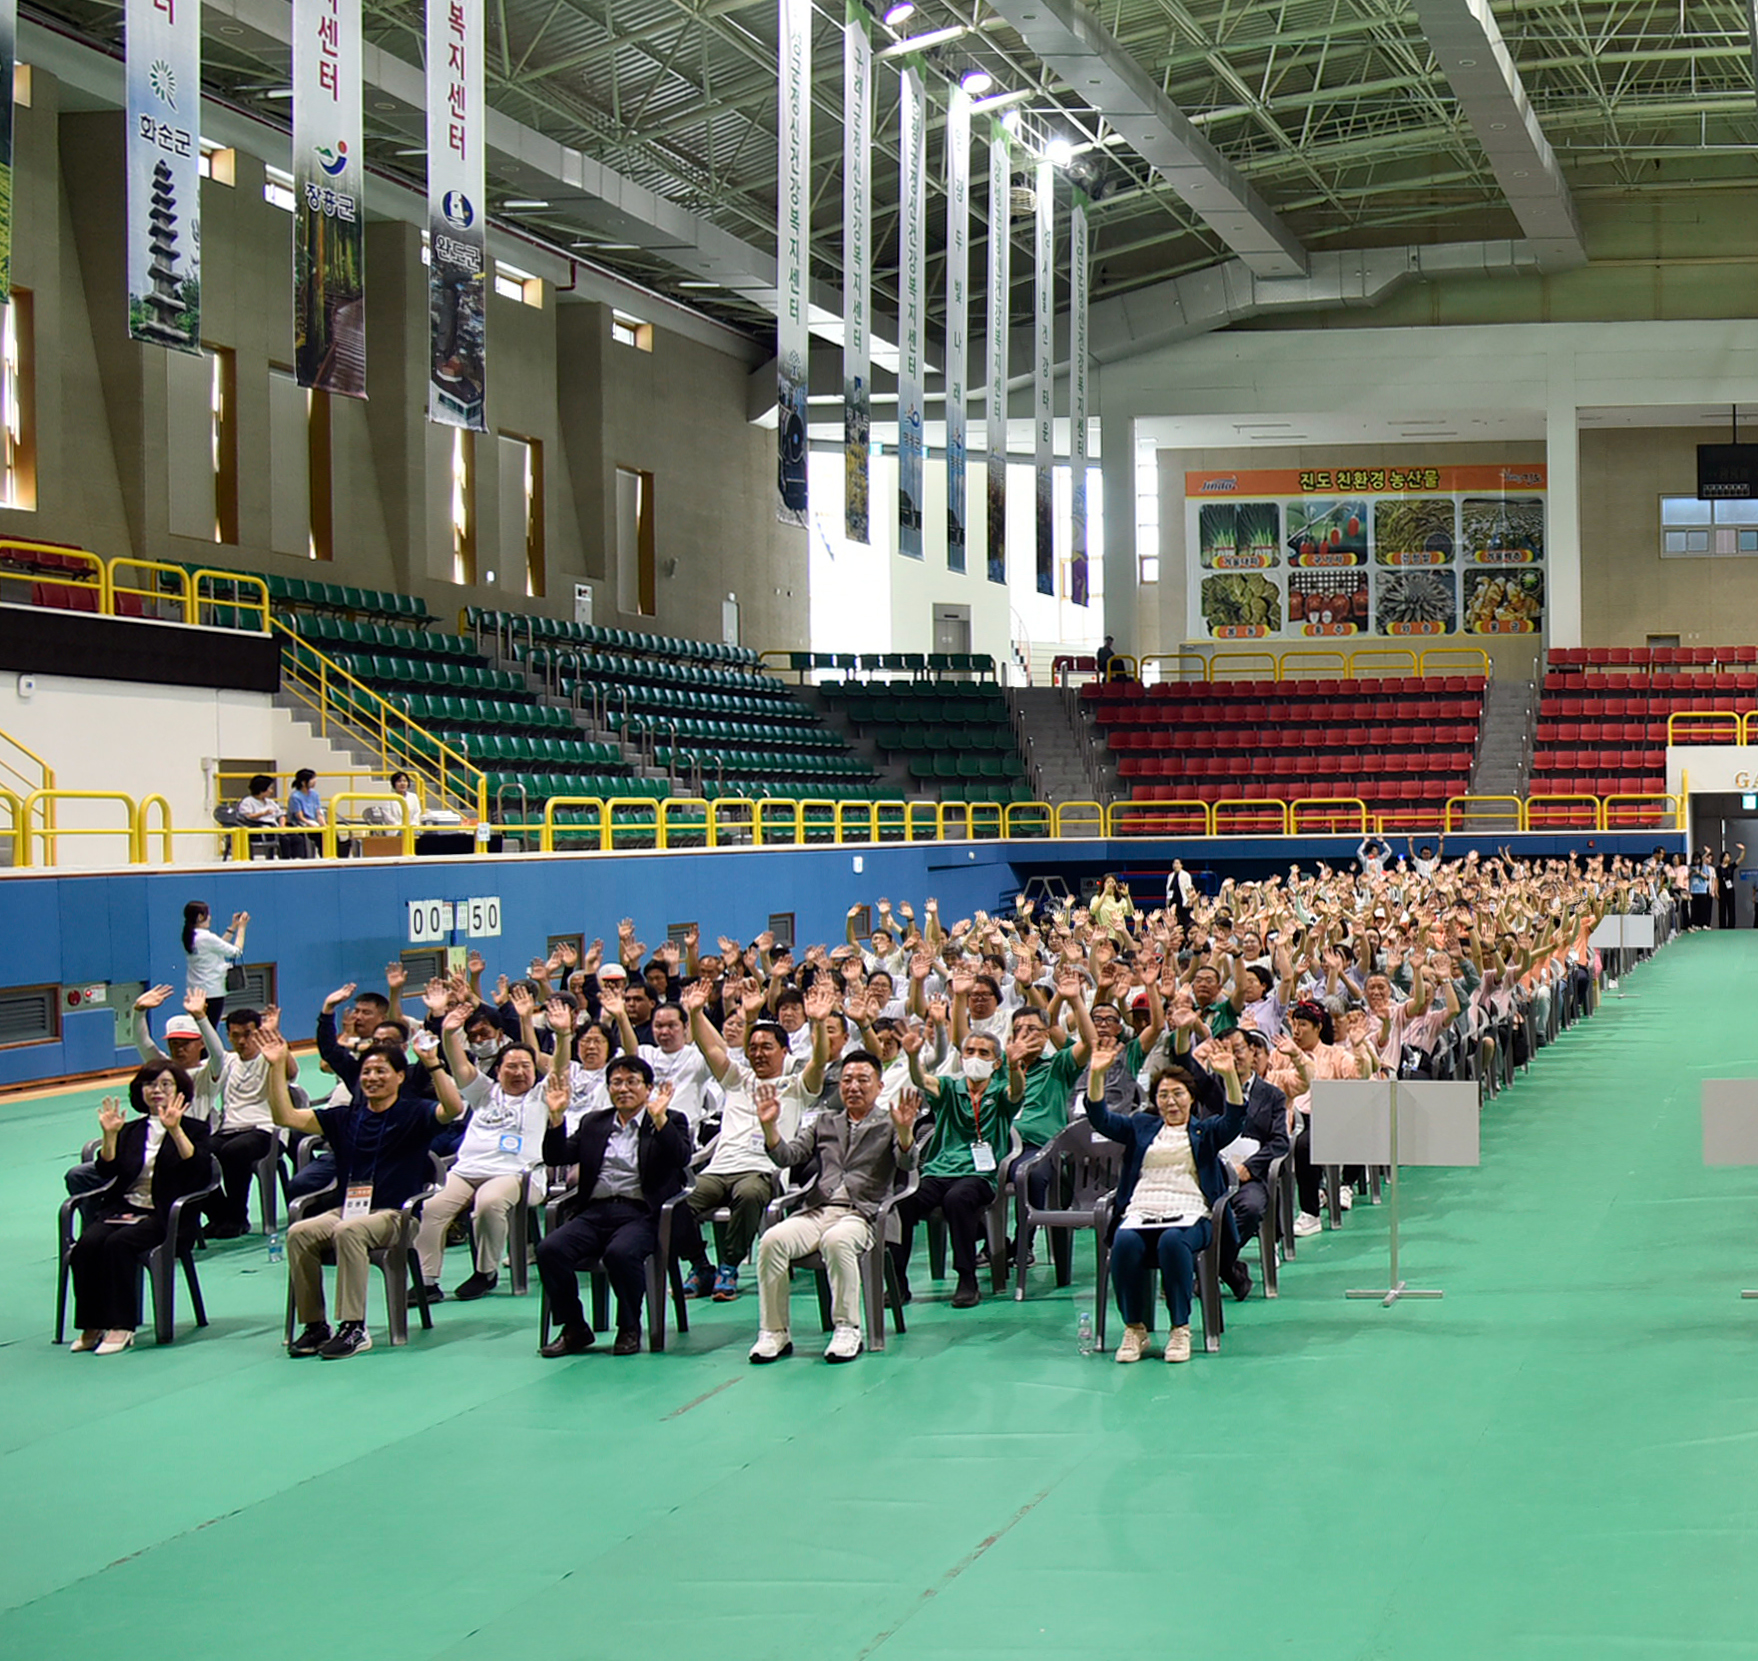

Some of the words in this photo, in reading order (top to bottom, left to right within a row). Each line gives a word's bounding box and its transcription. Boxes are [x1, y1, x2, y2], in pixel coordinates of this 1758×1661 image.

[140, 114, 191, 157] 화순군
[305, 182, 355, 222] 장흥군
[436, 234, 481, 271] 완도군
[1299, 471, 1332, 491] 진도
[1336, 469, 1386, 491] 친환경
[1389, 468, 1440, 490] 농산물
[1314, 555, 1343, 565] 구기자
[472, 904, 498, 931] 50
